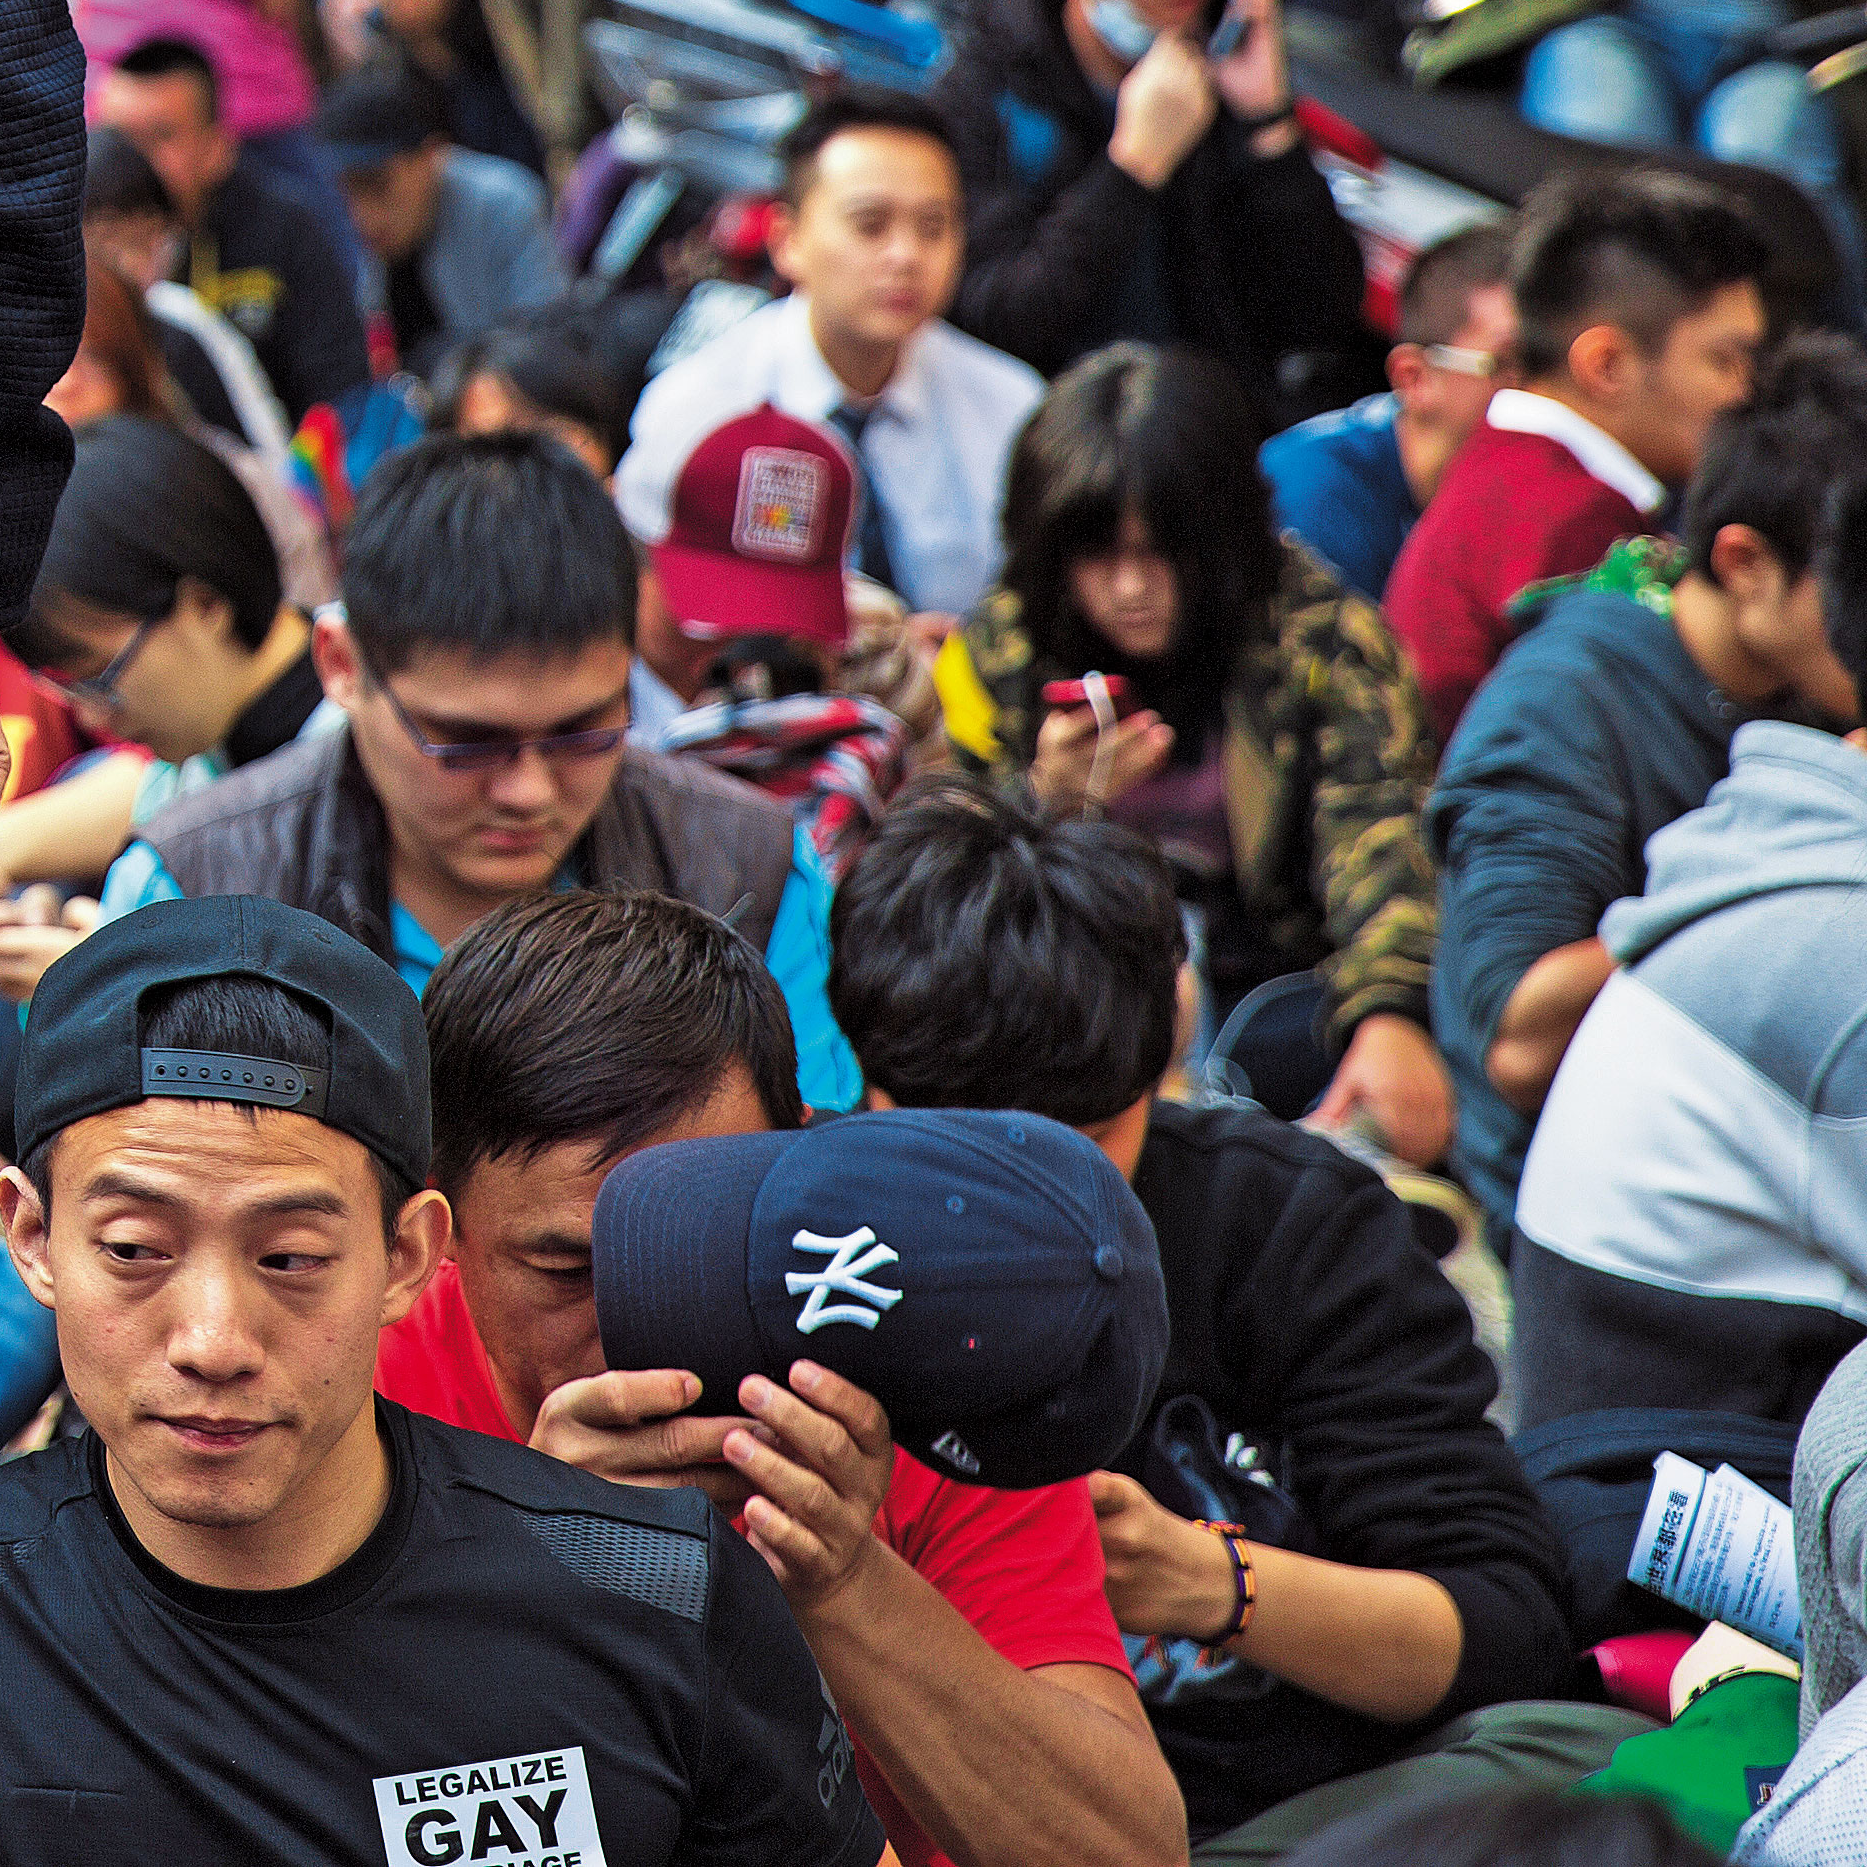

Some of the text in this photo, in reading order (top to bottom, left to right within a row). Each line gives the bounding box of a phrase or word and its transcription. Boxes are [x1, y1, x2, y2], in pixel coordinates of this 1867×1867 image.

[785, 1225, 904, 1334] NY
[395, 1756, 567, 1806] LEGALIZE
[405, 1788, 569, 1867] GAY
